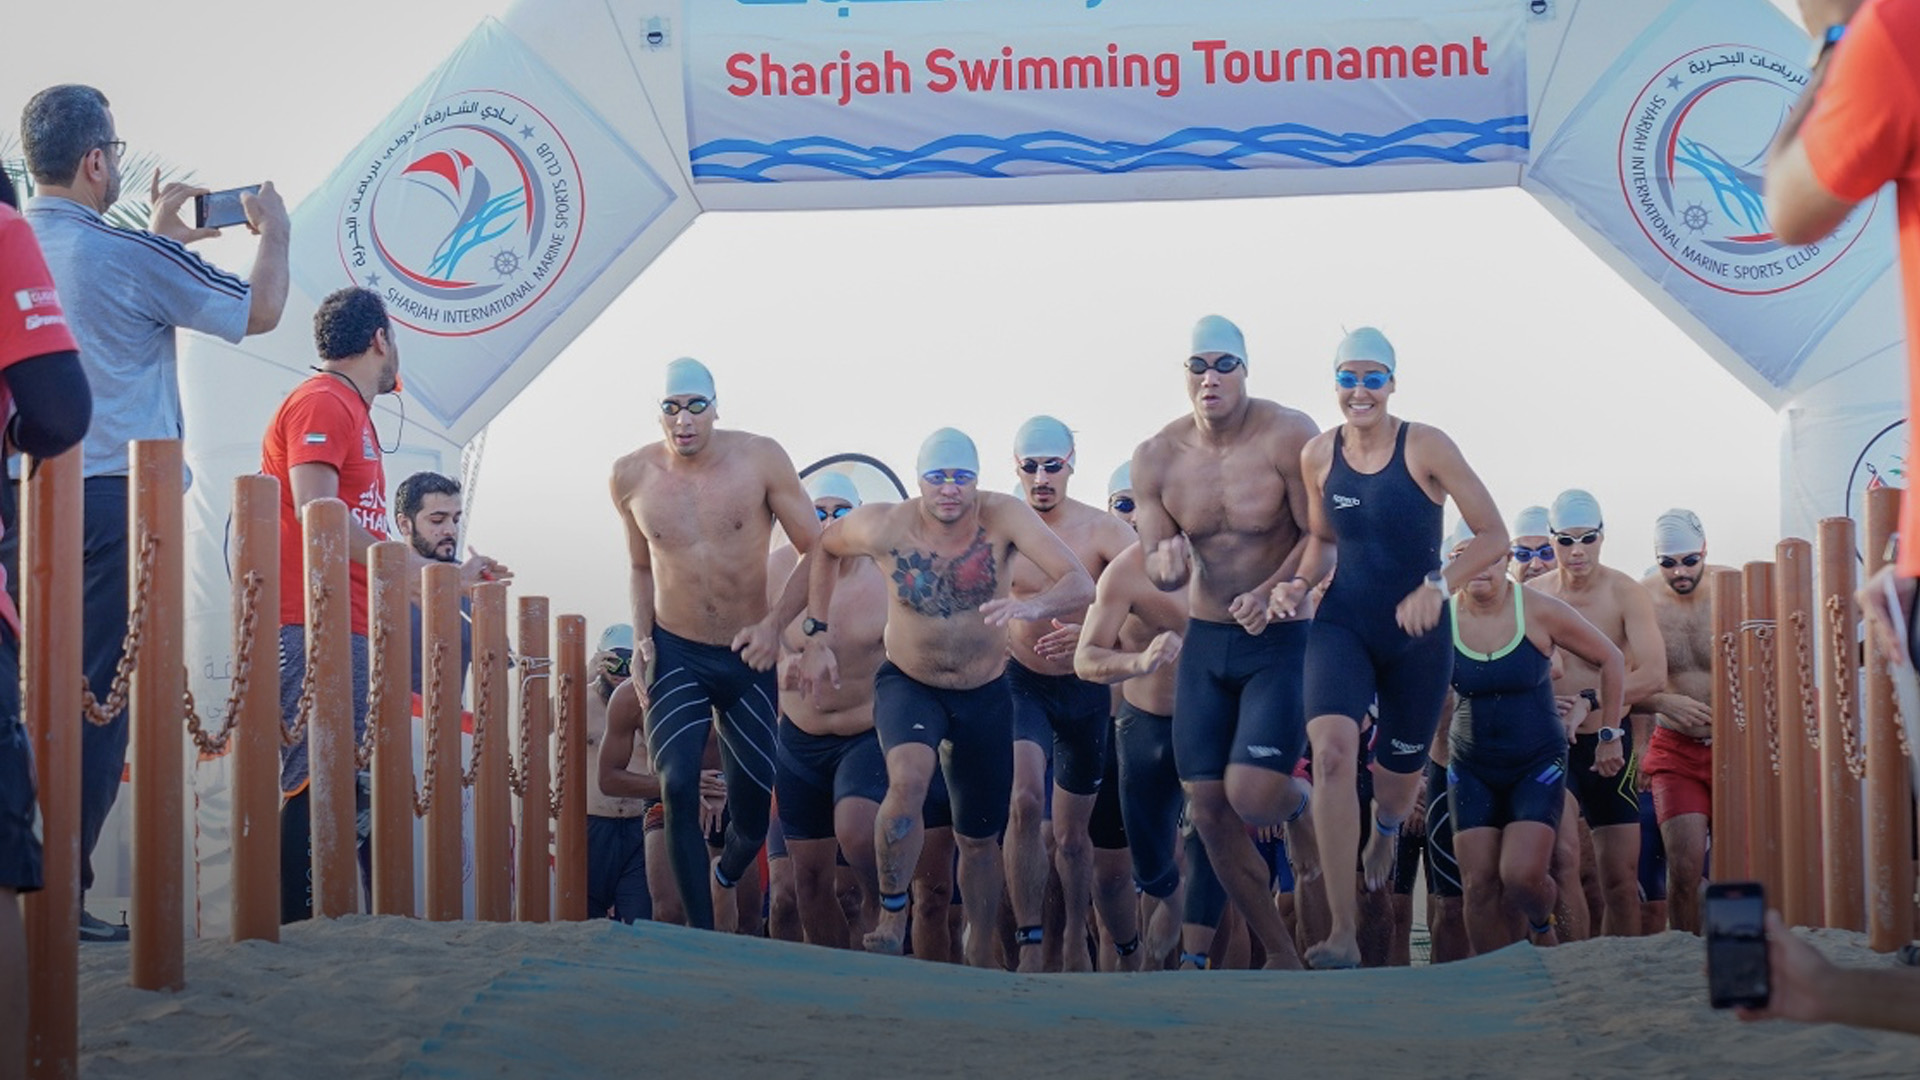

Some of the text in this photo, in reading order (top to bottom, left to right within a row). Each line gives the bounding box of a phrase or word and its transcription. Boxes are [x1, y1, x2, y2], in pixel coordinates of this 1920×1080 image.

[725, 36, 1490, 106] Sharjah Swimming Tournament
[1688, 52, 1744, 74] البحرية
[481, 105, 518, 125] نادي
[1632, 94, 1820, 280] SHARJAH INTERNATIONAL MARINE SPORTS CLUB
[345, 216, 366, 268] البحرية
[384, 142, 570, 324] SHARJAH INTERNATIONAL MARINE SPORTS CLUB
